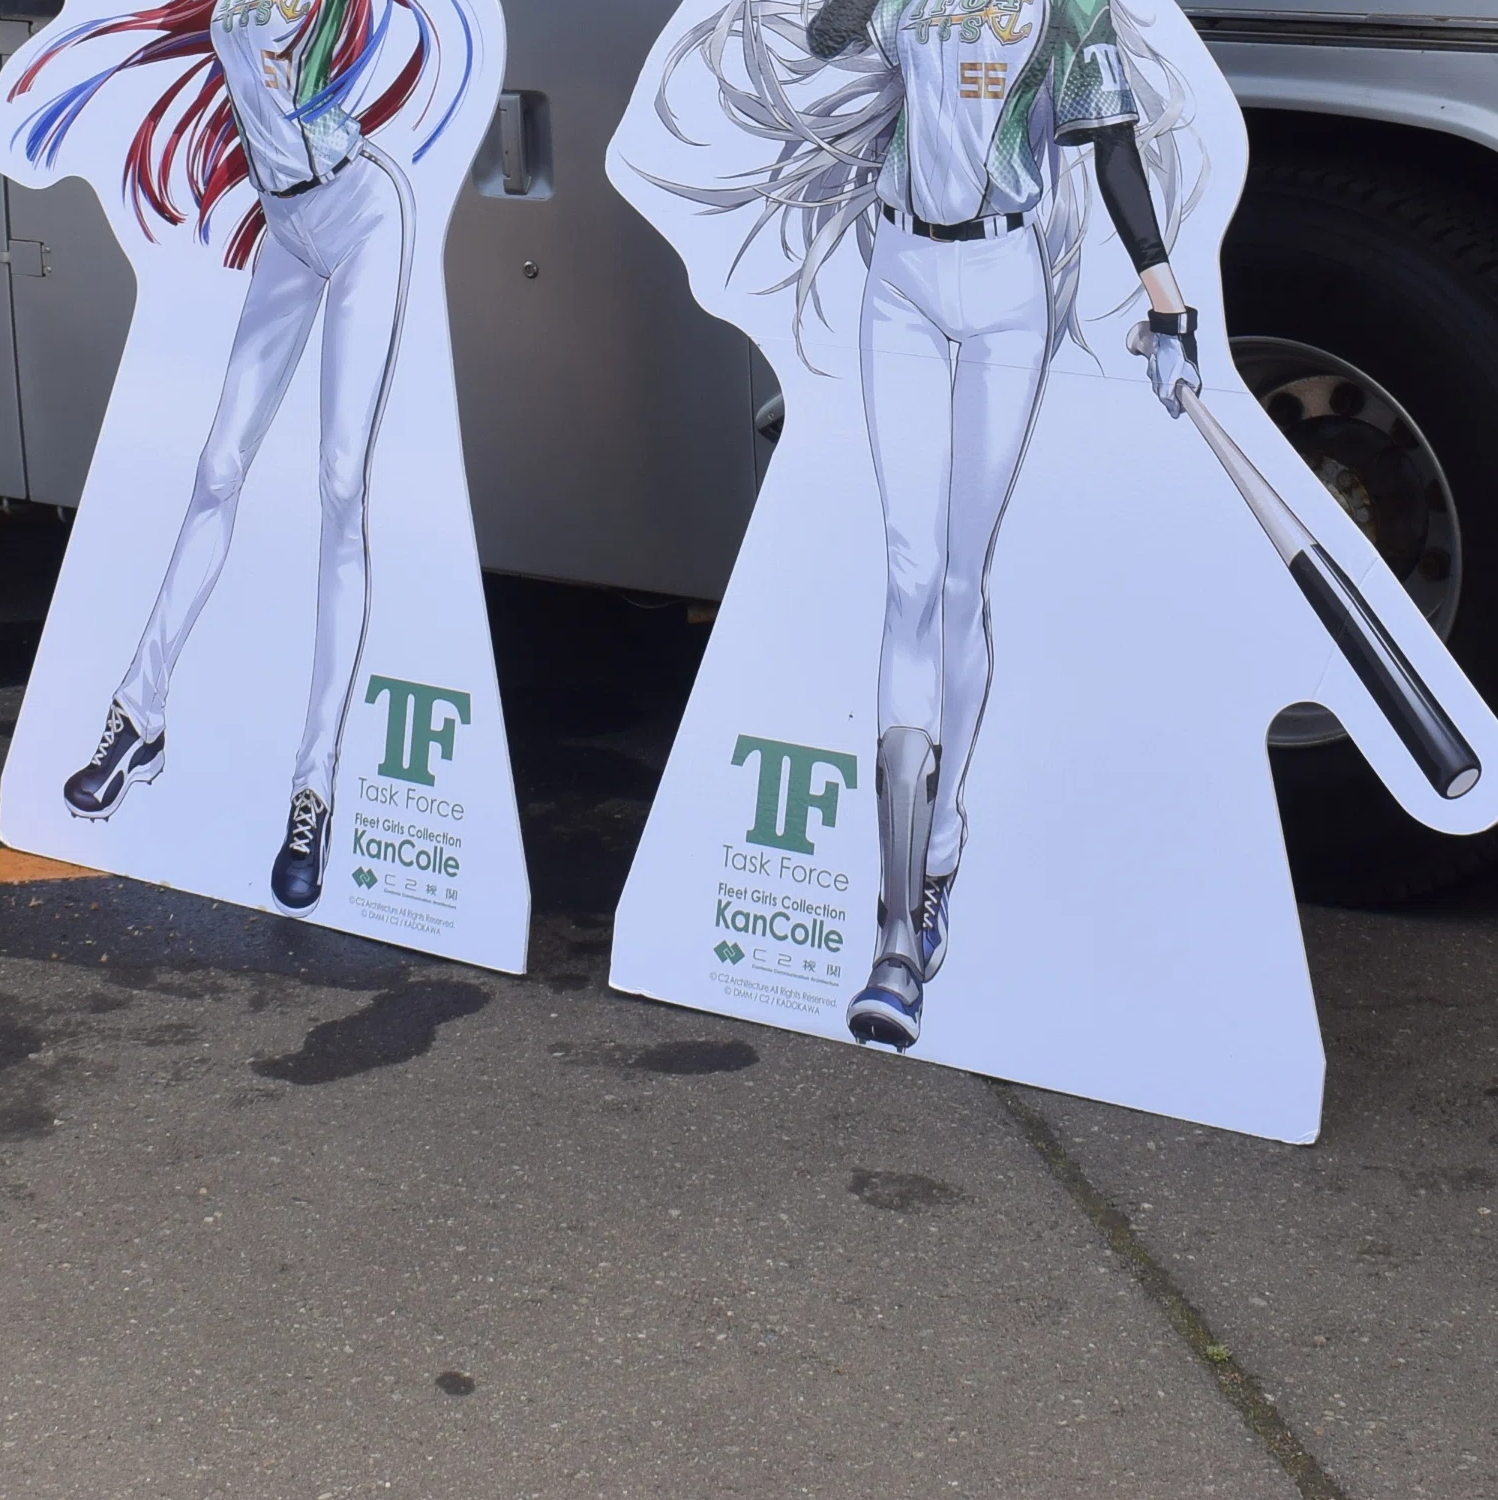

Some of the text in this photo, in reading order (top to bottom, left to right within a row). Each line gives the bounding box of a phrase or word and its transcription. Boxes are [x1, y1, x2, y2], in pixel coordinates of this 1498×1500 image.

[959, 62, 1008, 100] 56
[364, 674, 471, 787] TF
[358, 777, 464, 821] Task Force
[730, 733, 858, 855] TF
[354, 812, 462, 848] Fleet Girls Collection
[353, 828, 460, 878] KanColle
[722, 844, 849, 892] Task Force
[718, 882, 846, 921] Fleet Girls Collection
[715, 898, 844, 953] KanColle
[730, 975, 769, 993] Architecture
[770, 985, 779, 996] All
[780, 987, 801, 1000] Rights
[802, 992, 838, 1008] Reserved.
[759, 994, 770, 1005] C2
[776, 998, 821, 1015] KADOKAWA
